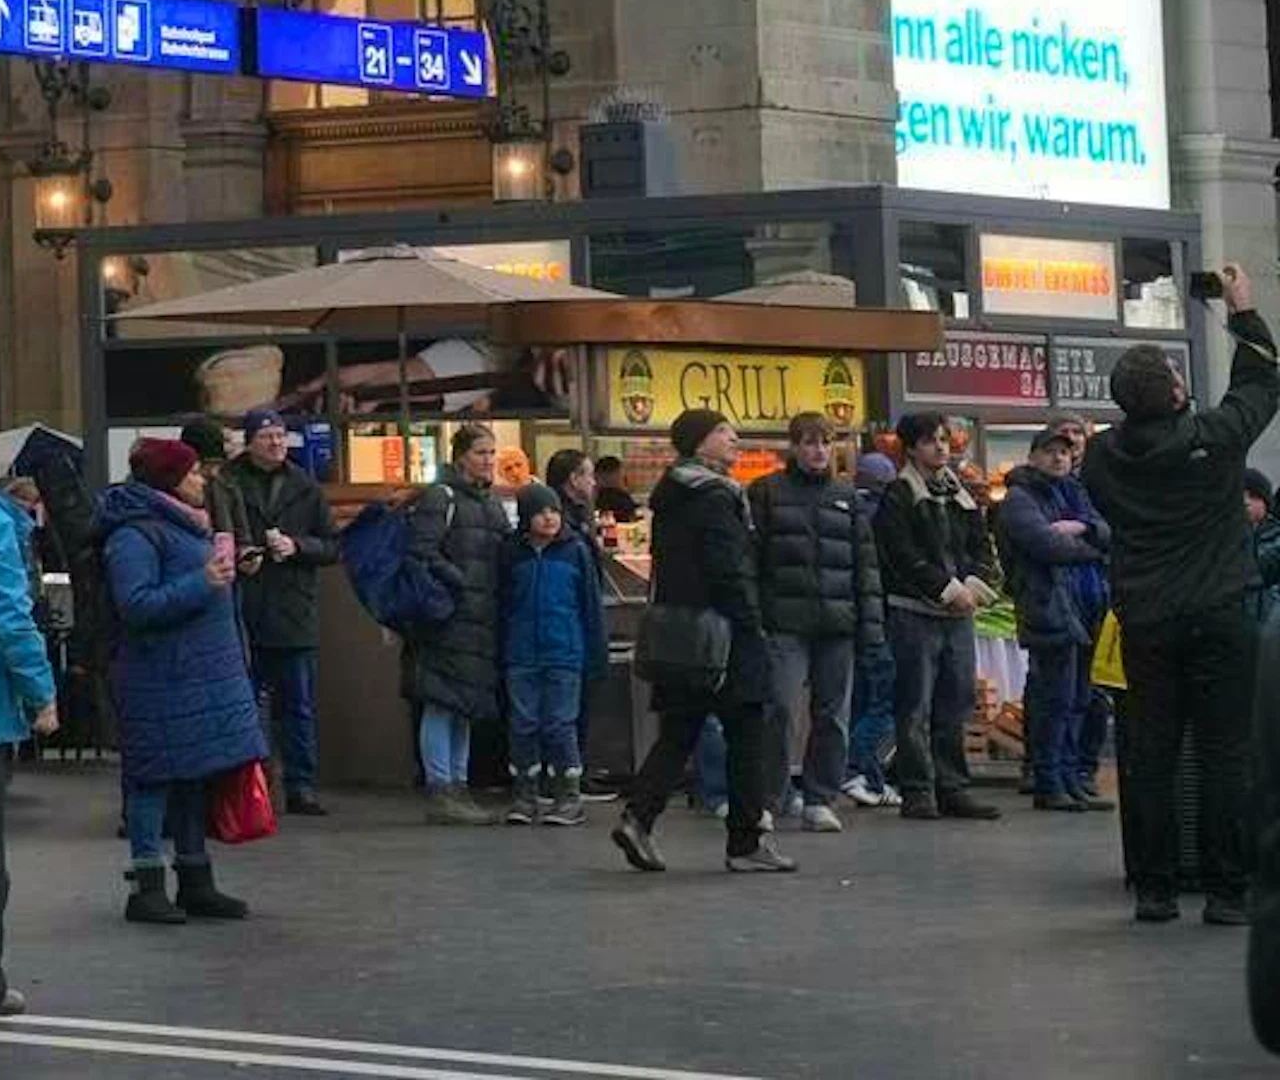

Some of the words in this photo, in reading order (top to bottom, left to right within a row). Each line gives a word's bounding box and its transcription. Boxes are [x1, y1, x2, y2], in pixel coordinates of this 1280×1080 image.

[365, 45, 386, 76] 21
[420, 52, 444, 81] 34
[946, 9, 1003, 69] alle
[1013, 17, 1129, 93] nicken,
[959, 94, 1017, 164] wir,
[1026, 111, 1146, 166] warum.
[681, 361, 799, 420] GRILL
